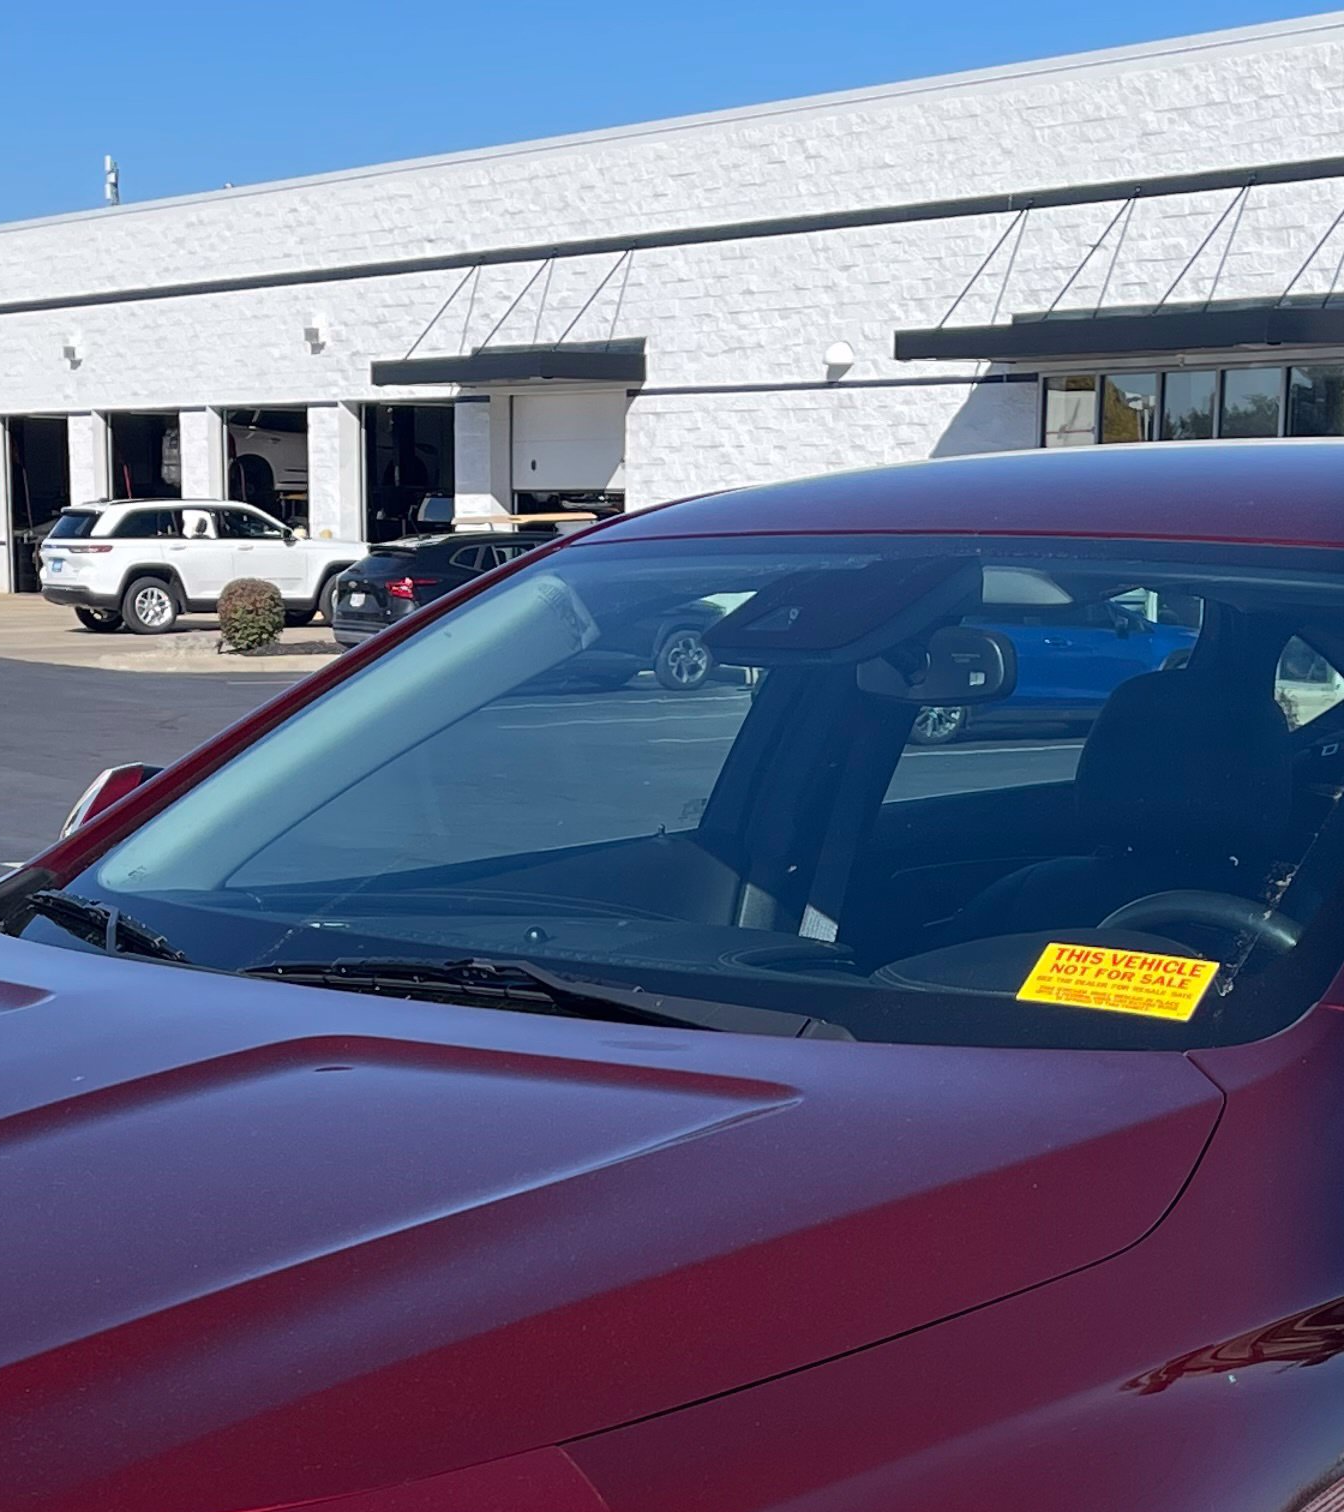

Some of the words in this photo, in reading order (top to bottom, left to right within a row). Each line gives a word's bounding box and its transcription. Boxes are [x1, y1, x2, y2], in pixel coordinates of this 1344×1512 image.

[1049, 962, 1091, 977] NOT
[1093, 967, 1135, 982] FOR
[1139, 973, 1192, 990] SALE
[1056, 947, 1105, 965] THIS
[1111, 953, 1207, 978] VEHICLE
